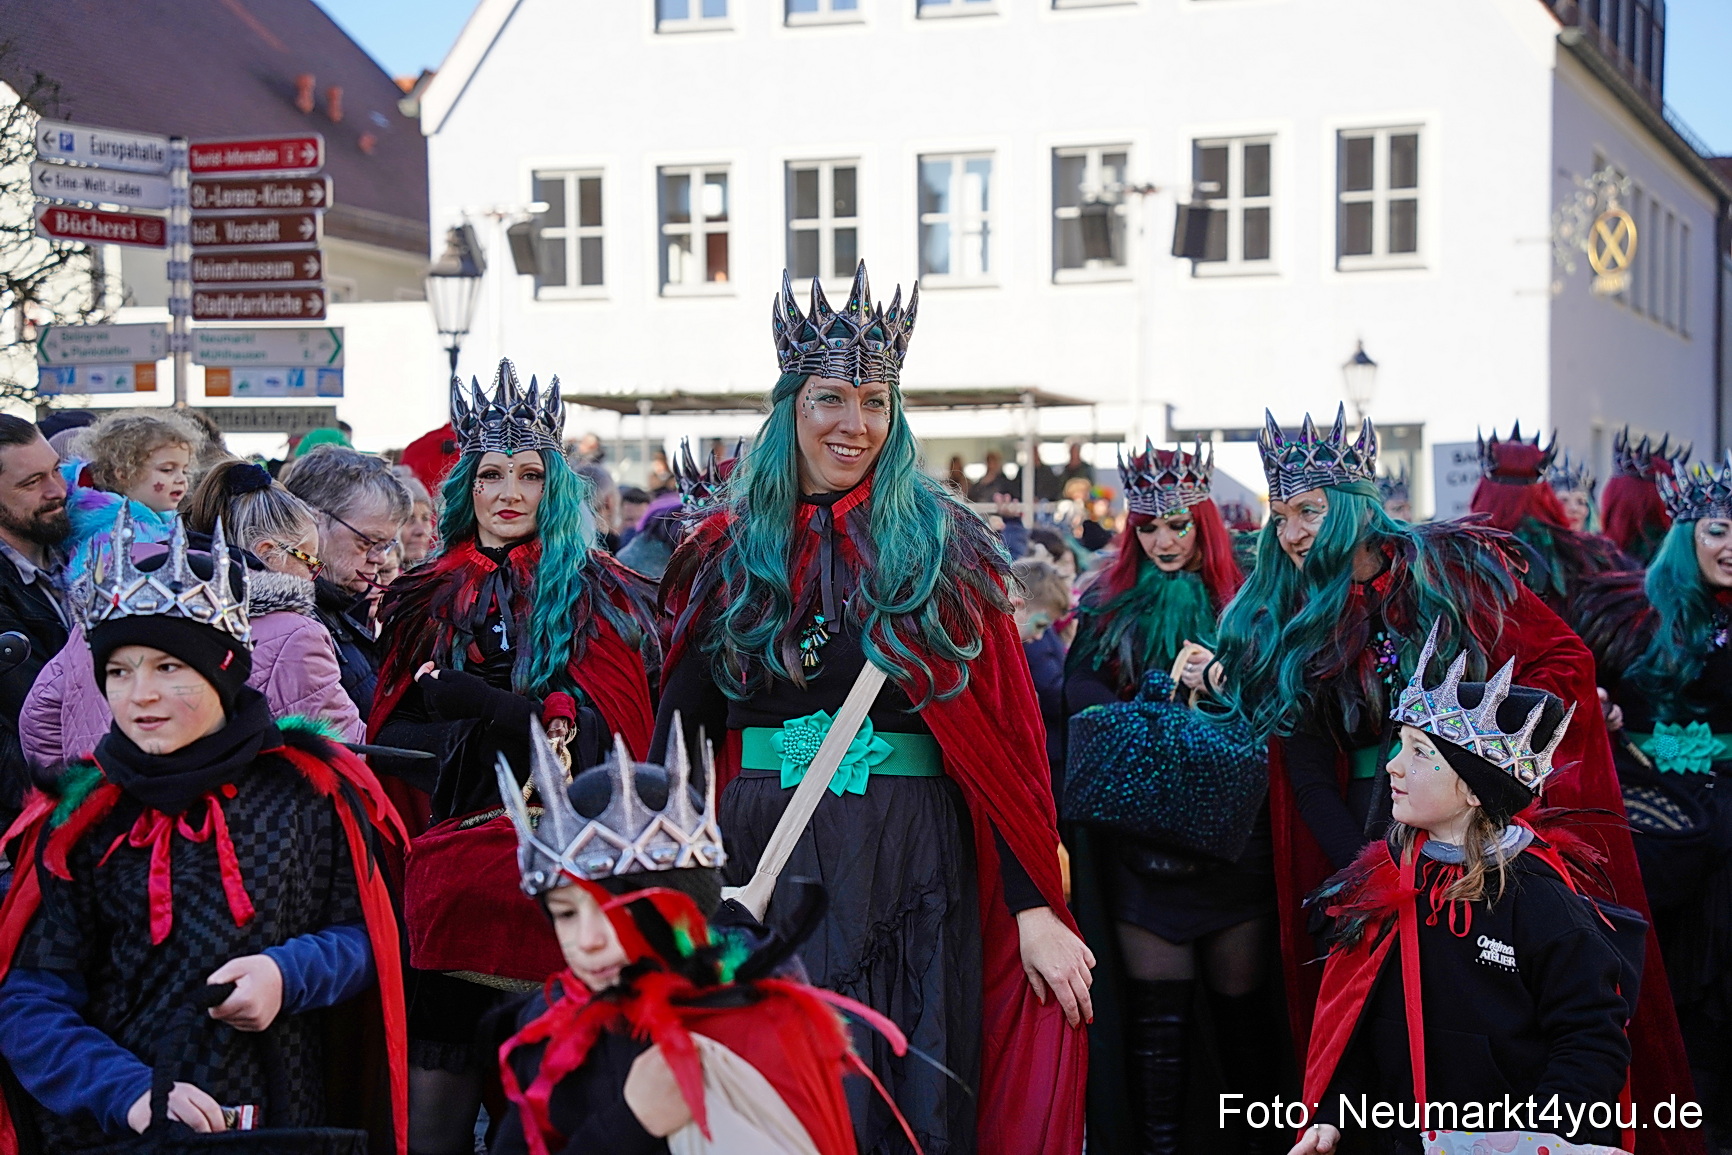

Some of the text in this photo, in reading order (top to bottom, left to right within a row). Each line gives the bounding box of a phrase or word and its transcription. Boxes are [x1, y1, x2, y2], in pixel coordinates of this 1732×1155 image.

[90, 134, 164, 161] Europahalle
[192, 146, 279, 168] Tourist-Information
[55, 173, 142, 197] Eine-Welt-Laden
[192, 183, 304, 207] St.-Lorenz-Kirche
[55, 211, 137, 240] Bücherei
[193, 219, 280, 243] hist. Vorstadt
[194, 257, 295, 280] Heimatmuseum
[194, 292, 303, 318] Stadtpfarrkirche
[1479, 949, 1516, 967] ATELIER
